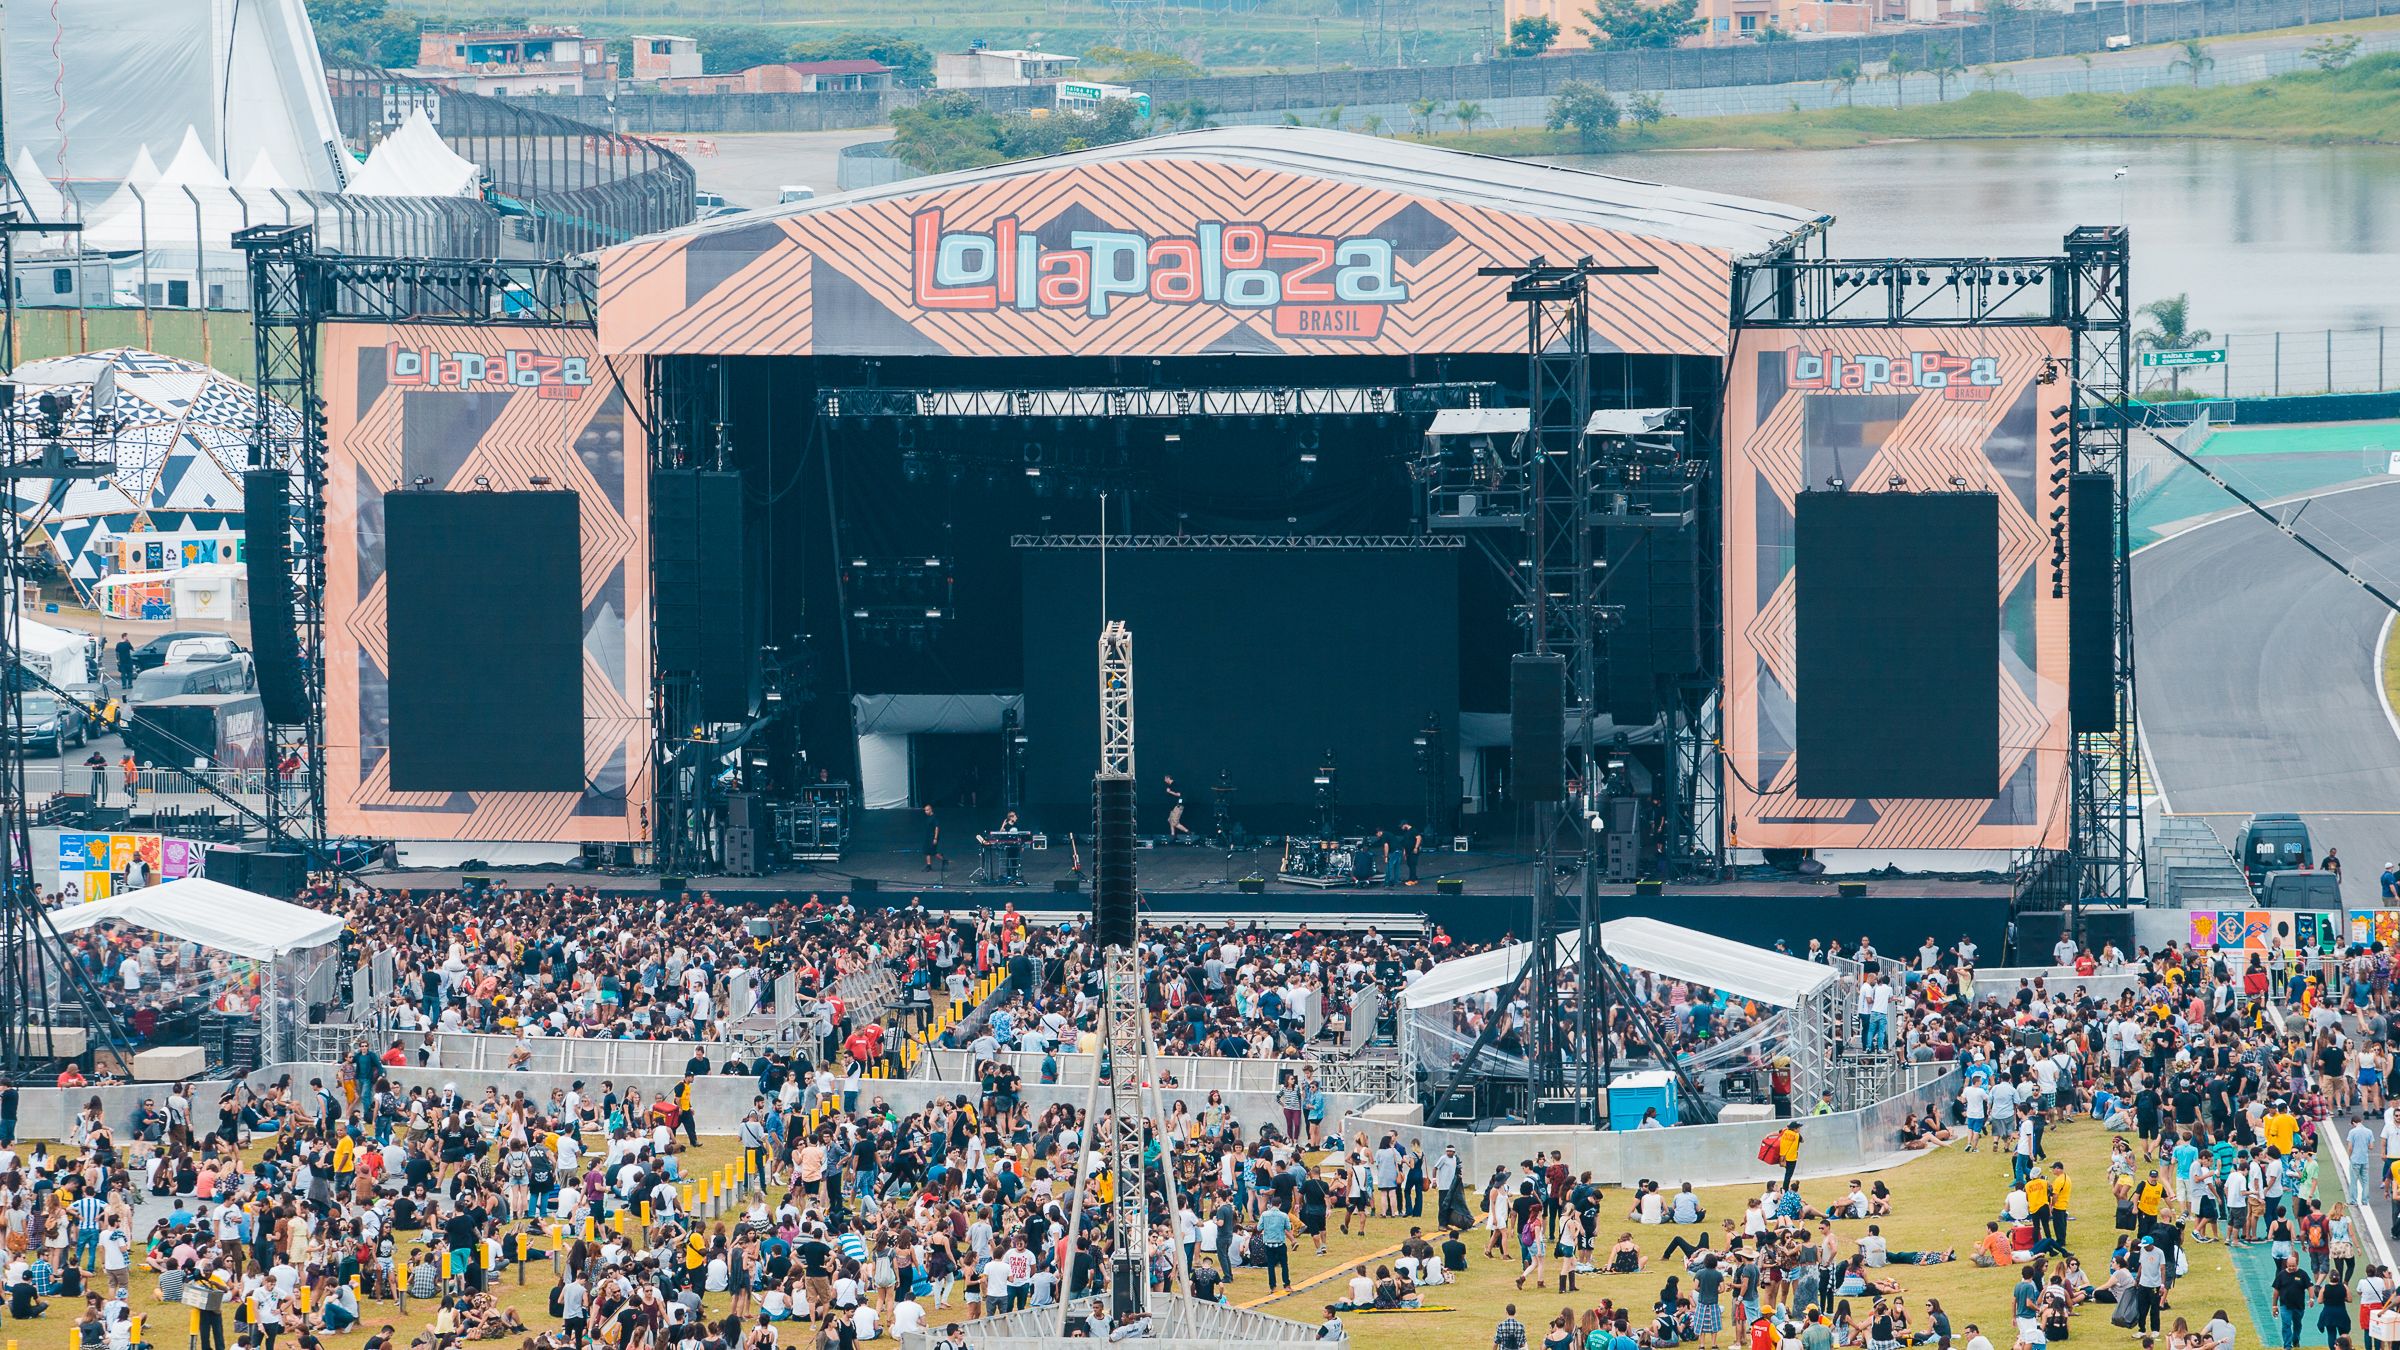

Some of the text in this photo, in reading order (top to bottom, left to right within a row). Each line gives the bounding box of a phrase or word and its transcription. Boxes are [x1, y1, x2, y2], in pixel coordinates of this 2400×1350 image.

[414, 99, 435, 109] ZU
[912, 206, 1410, 319] Lollapalooza
[1299, 308, 1361, 333] BRASIL
[386, 341, 593, 390] Lollapalooza
[1786, 345, 2003, 393] Lollapalooza
[1954, 388, 1984, 399] BRASIL
[2256, 842, 2302, 854] AM PM
